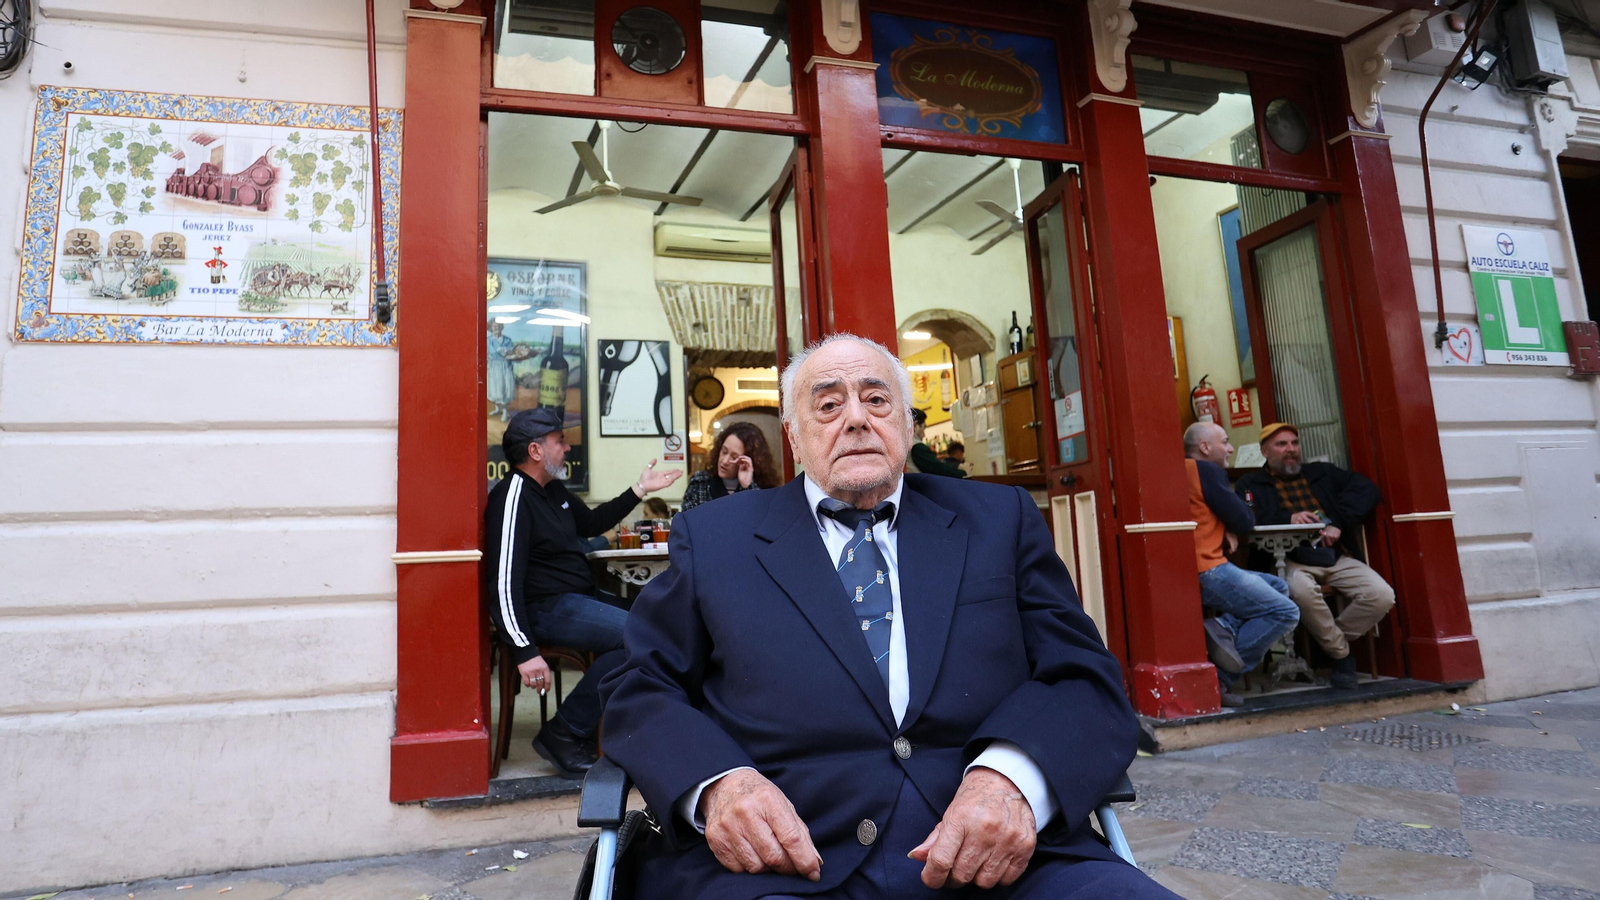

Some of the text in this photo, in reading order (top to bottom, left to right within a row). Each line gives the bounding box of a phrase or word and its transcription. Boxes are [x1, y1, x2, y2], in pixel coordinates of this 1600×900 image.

[909, 61, 1025, 95] La Moderna
[182, 219, 254, 232] GONZALEZ BYASS
[1471, 256, 1550, 271] AUTO ESCUELA CALIZ
[506, 270, 576, 286] OSBORNE
[212, 287, 239, 295] PEPE
[511, 286, 534, 297] VINOS
[1497, 279, 1541, 345] L
[152, 323, 274, 337] Bar La Moderna
